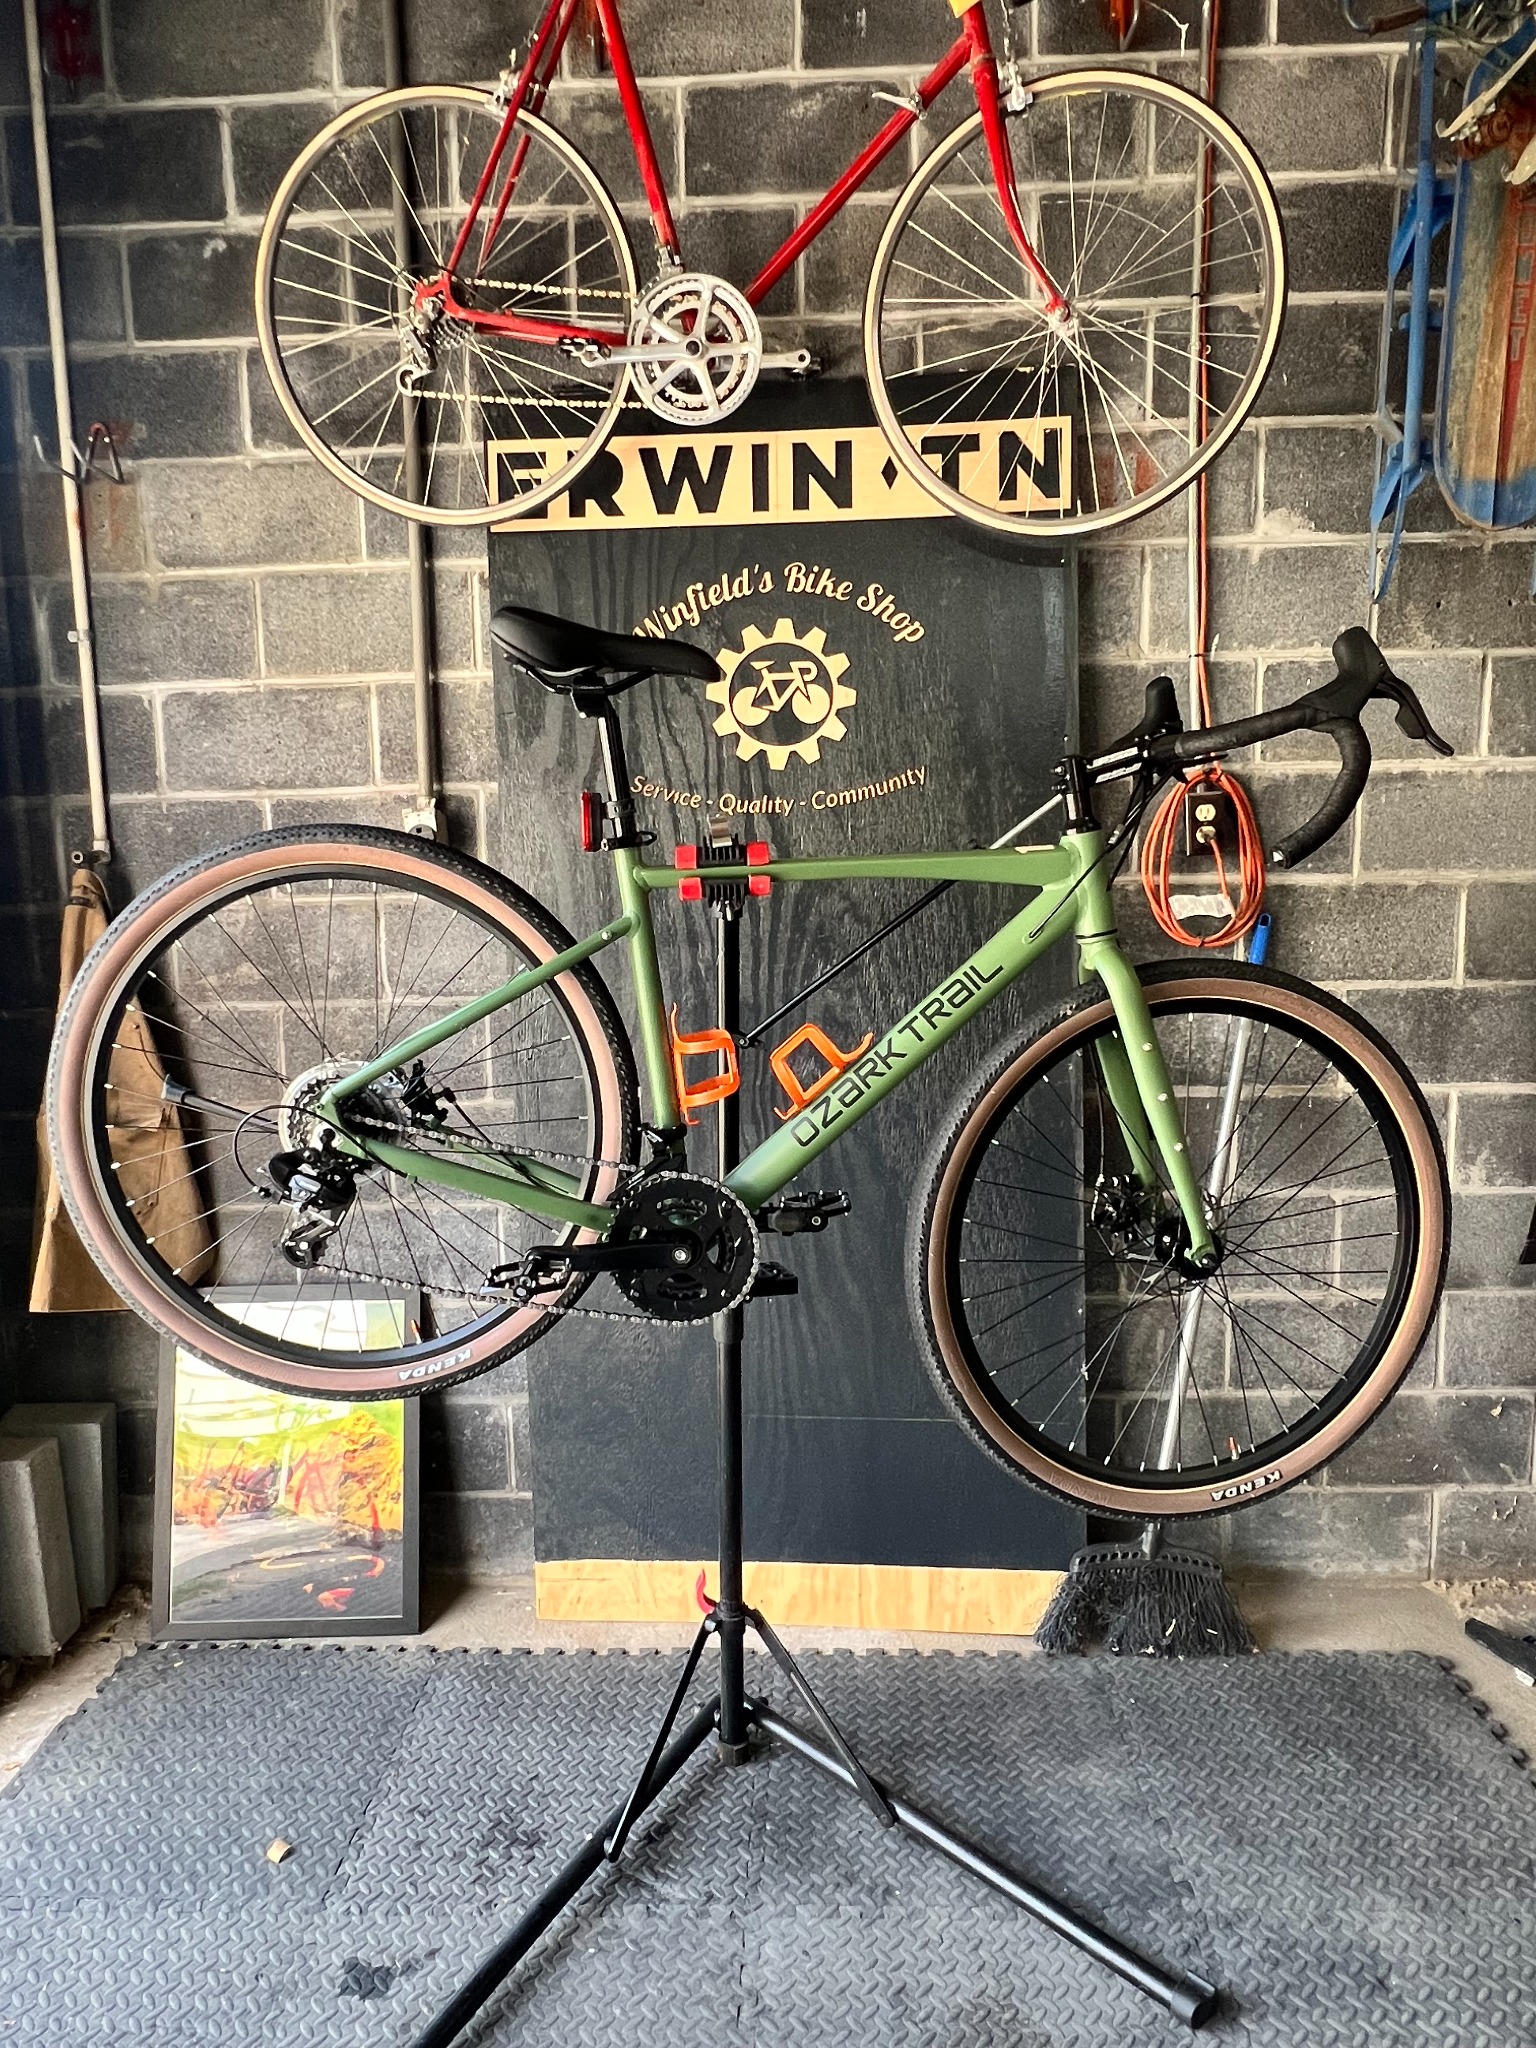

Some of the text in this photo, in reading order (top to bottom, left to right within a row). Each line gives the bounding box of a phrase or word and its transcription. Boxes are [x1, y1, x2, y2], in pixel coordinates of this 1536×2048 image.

[497, 427, 1062, 520] ERWIN TN
[631, 561, 926, 644] Winfield's Bike Shop
[629, 774, 702, 809] Service
[718, 792, 795, 817] Quality
[811, 764, 927, 811] Community
[790, 1037, 908, 1147] OZARK
[398, 1348, 472, 1381] KENDA
[1210, 1469, 1283, 1502] KENDA
